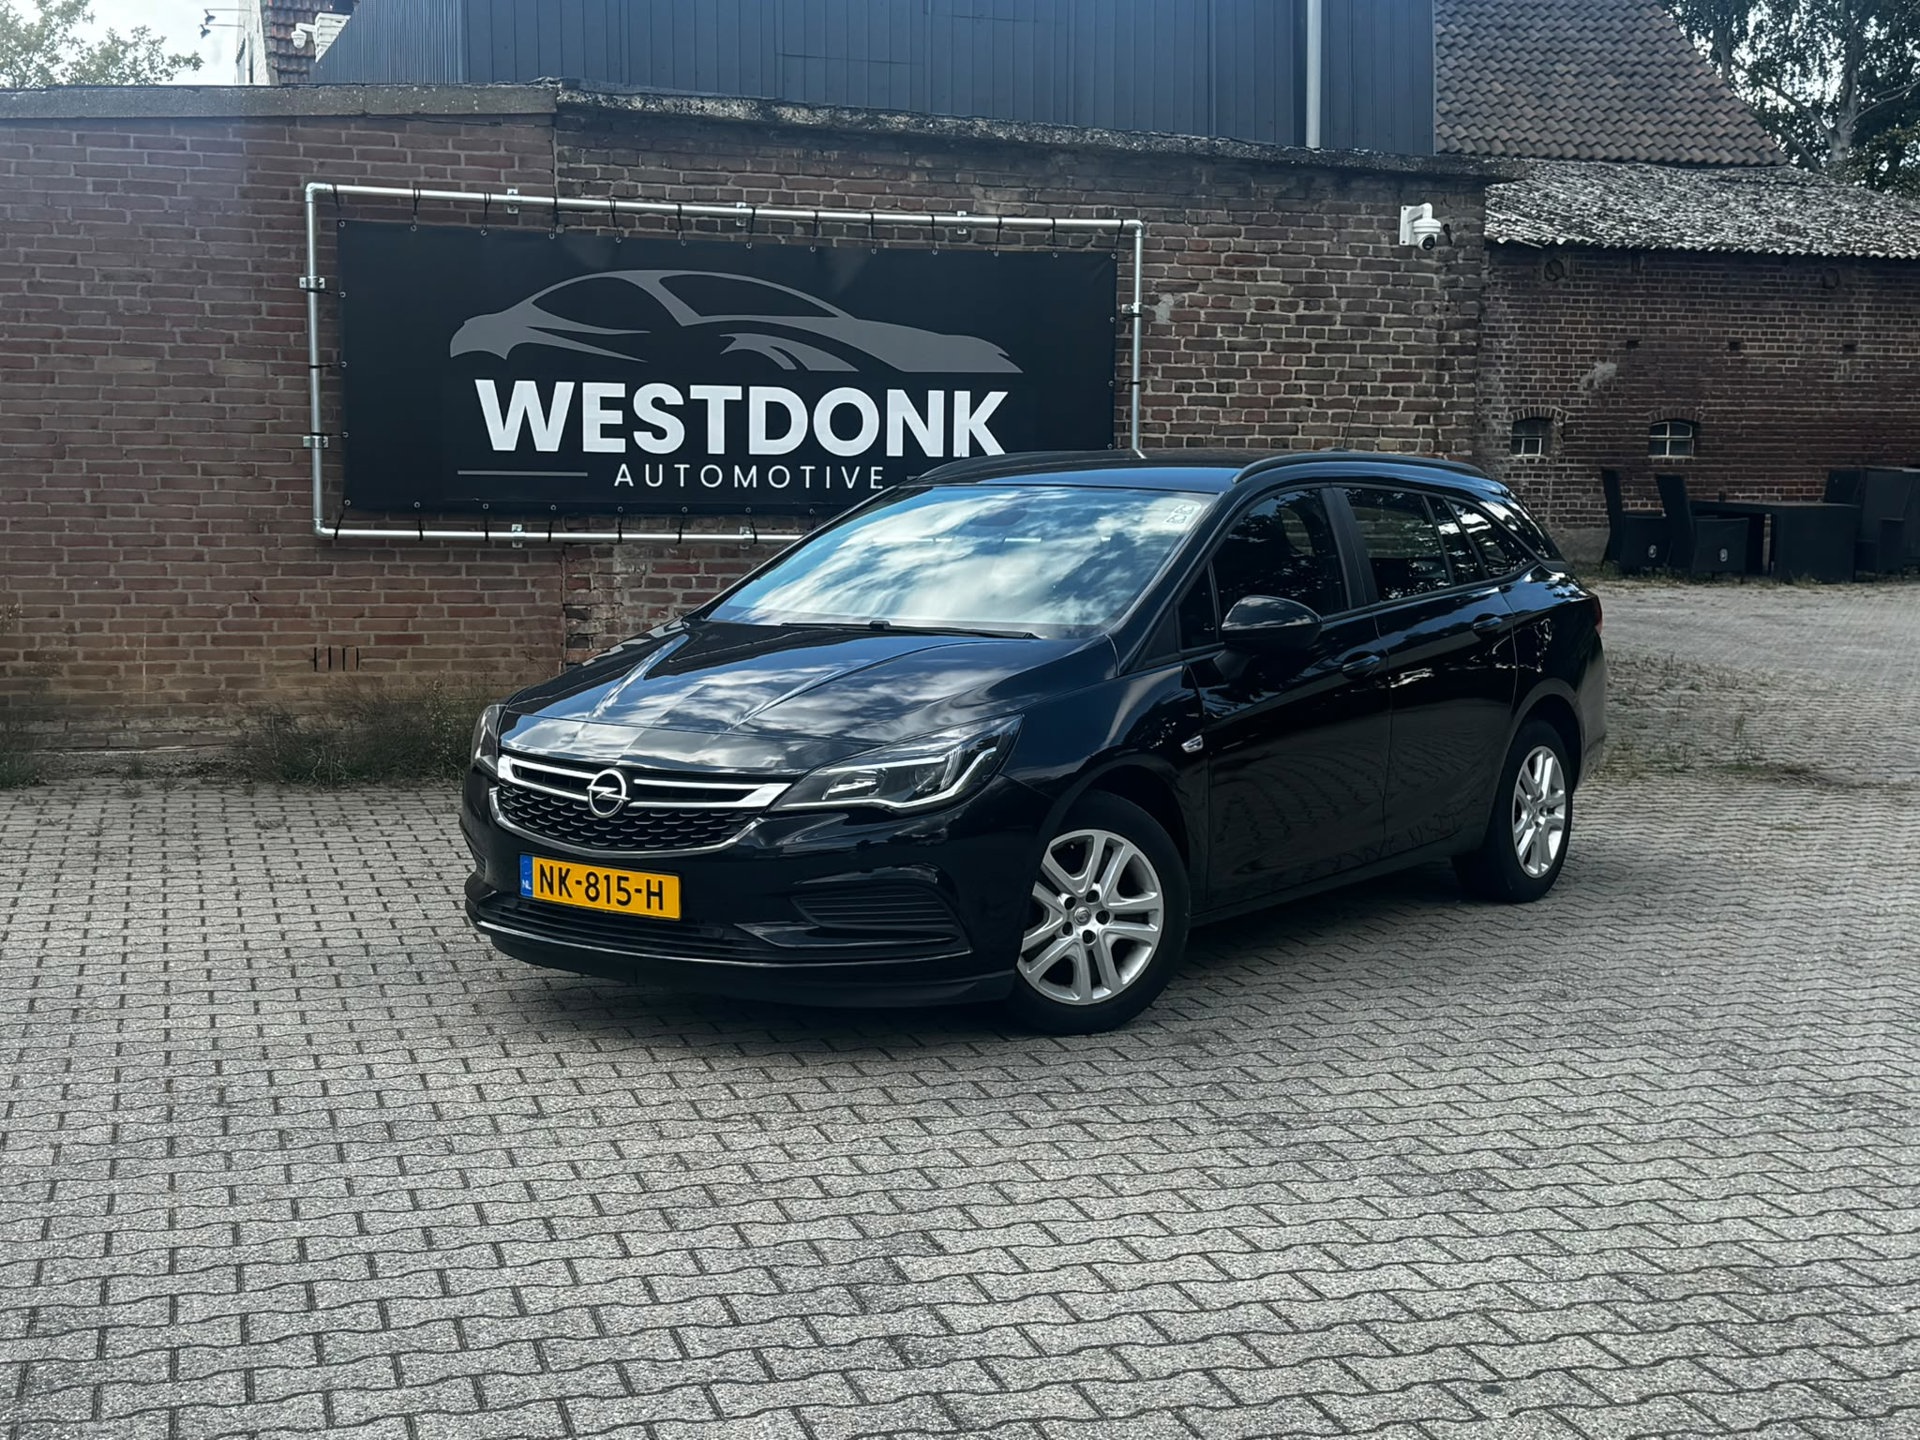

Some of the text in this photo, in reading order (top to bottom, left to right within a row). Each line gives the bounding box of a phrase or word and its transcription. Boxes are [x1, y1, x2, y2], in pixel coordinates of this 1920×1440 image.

[475, 379, 1009, 459] WESTDONK
[613, 463, 885, 491] AUTOMOTIVE
[521, 879, 532, 890] NL
[539, 864, 664, 910] NK-815-H
